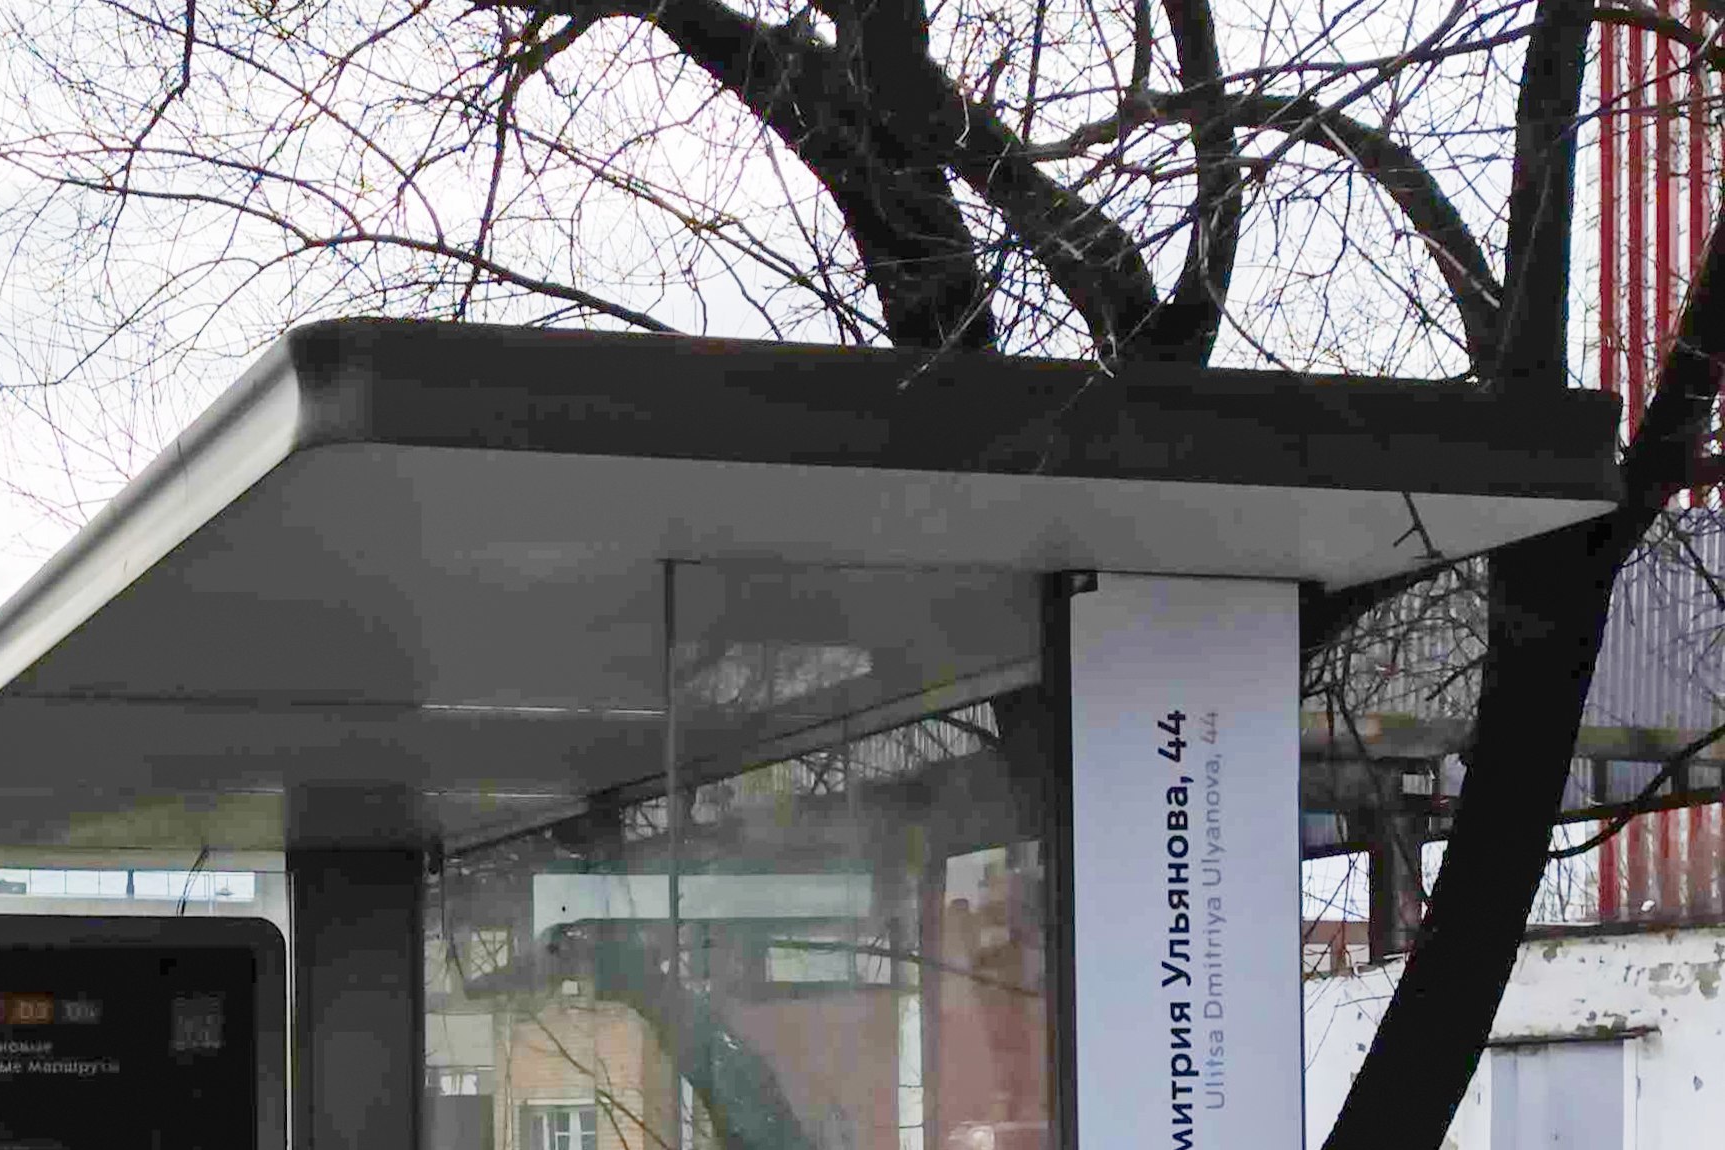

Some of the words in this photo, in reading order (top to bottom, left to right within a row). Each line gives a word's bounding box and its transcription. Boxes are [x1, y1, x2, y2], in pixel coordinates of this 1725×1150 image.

[1157, 710, 1187, 763] 44
[1199, 711, 1219, 745] 44
[1200, 752, 1226, 887] Ulyanova,
[1161, 776, 1195, 988] Ульянова,
[1202, 896, 1227, 1020] Dmitriya
[1204, 1029, 1226, 1110] Ulitsa
